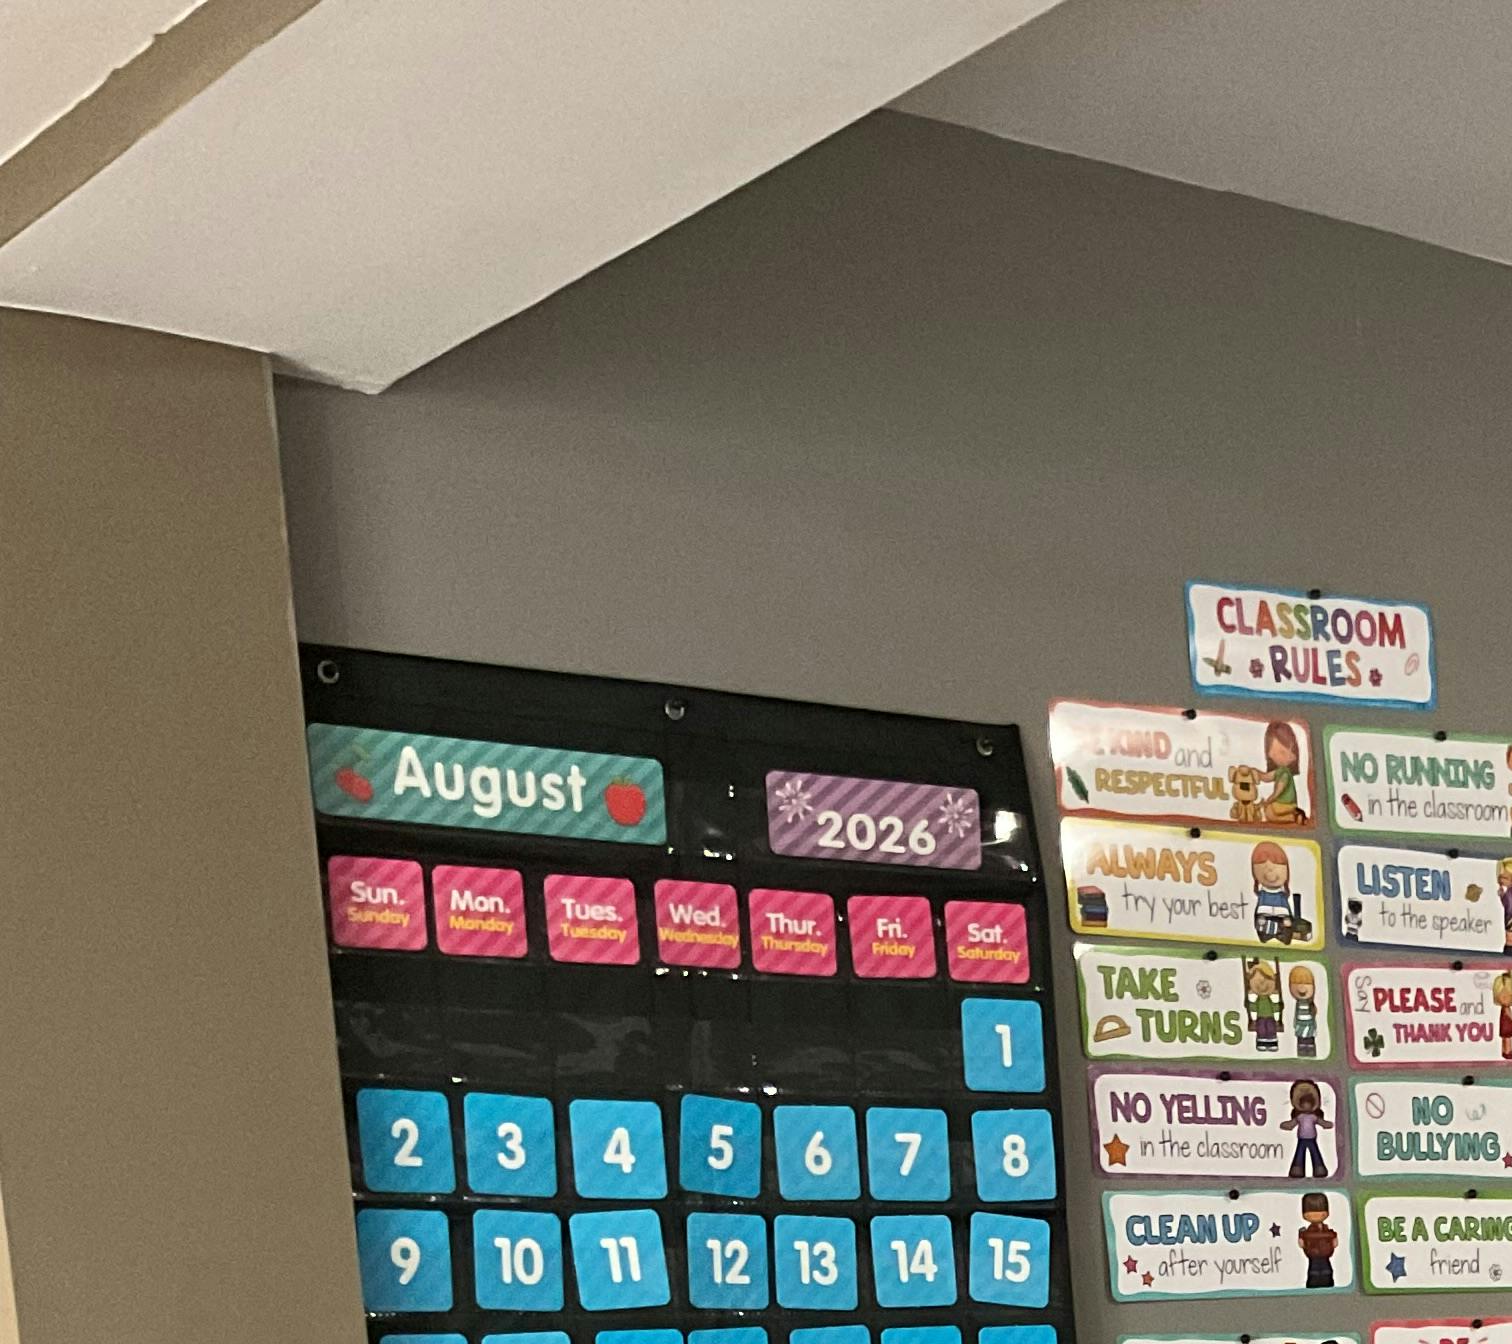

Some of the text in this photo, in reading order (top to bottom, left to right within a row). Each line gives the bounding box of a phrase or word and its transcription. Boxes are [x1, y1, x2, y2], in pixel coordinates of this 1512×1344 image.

[1216, 596, 1406, 650] CLASSROOM
[1268, 645, 1362, 688] RULES
[1175, 735, 1213, 768] and
[1340, 751, 1497, 789] NO RUNNING
[394, 746, 586, 818] August
[1095, 767, 1230, 801] RESPECTFUL
[1368, 789, 1509, 822] in the classroom
[817, 810, 936, 856] 2026
[1086, 847, 1218, 887] ALWAYS
[1357, 863, 1451, 901] LISTEN
[350, 882, 1008, 944] Sun. Mon. Tues. Wed. Thur. Fri. Sat.
[1121, 884, 1250, 922] try your best
[347, 907, 410, 928] Sunday
[449, 915, 514, 935] Monday
[561, 922, 627, 944] Tuesday
[761, 936, 828, 957] Thursday
[872, 941, 917, 960] Friday
[957, 946, 1021, 965] Saturday
[1379, 903, 1493, 942] to the speaker
[1098, 965, 1179, 1002] TAKE
[1355, 975, 1373, 1013] Say
[1373, 987, 1485, 1016] PLEASE and
[995, 1024, 1013, 1068] 1
[1135, 1008, 1243, 1046] TURNS
[1393, 1021, 1494, 1044] THANK YOU
[1109, 1092, 1268, 1126] NO YELLING
[1412, 1095, 1454, 1125] NO
[391, 1118, 1029, 1178] 2 3 4 5 6 7 8
[1138, 1132, 1284, 1161] in the classroom
[1376, 1130, 1501, 1162] BULLYING
[1125, 1213, 1260, 1246] CLEAN UP
[1376, 1216, 1408, 1242] BE
[1411, 1217, 1429, 1242] A
[390, 1236, 1032, 1286] 9 10 11 12 13 14 15
[1158, 1253, 1283, 1286] after yourself
[1430, 1248, 1481, 1277] friend
